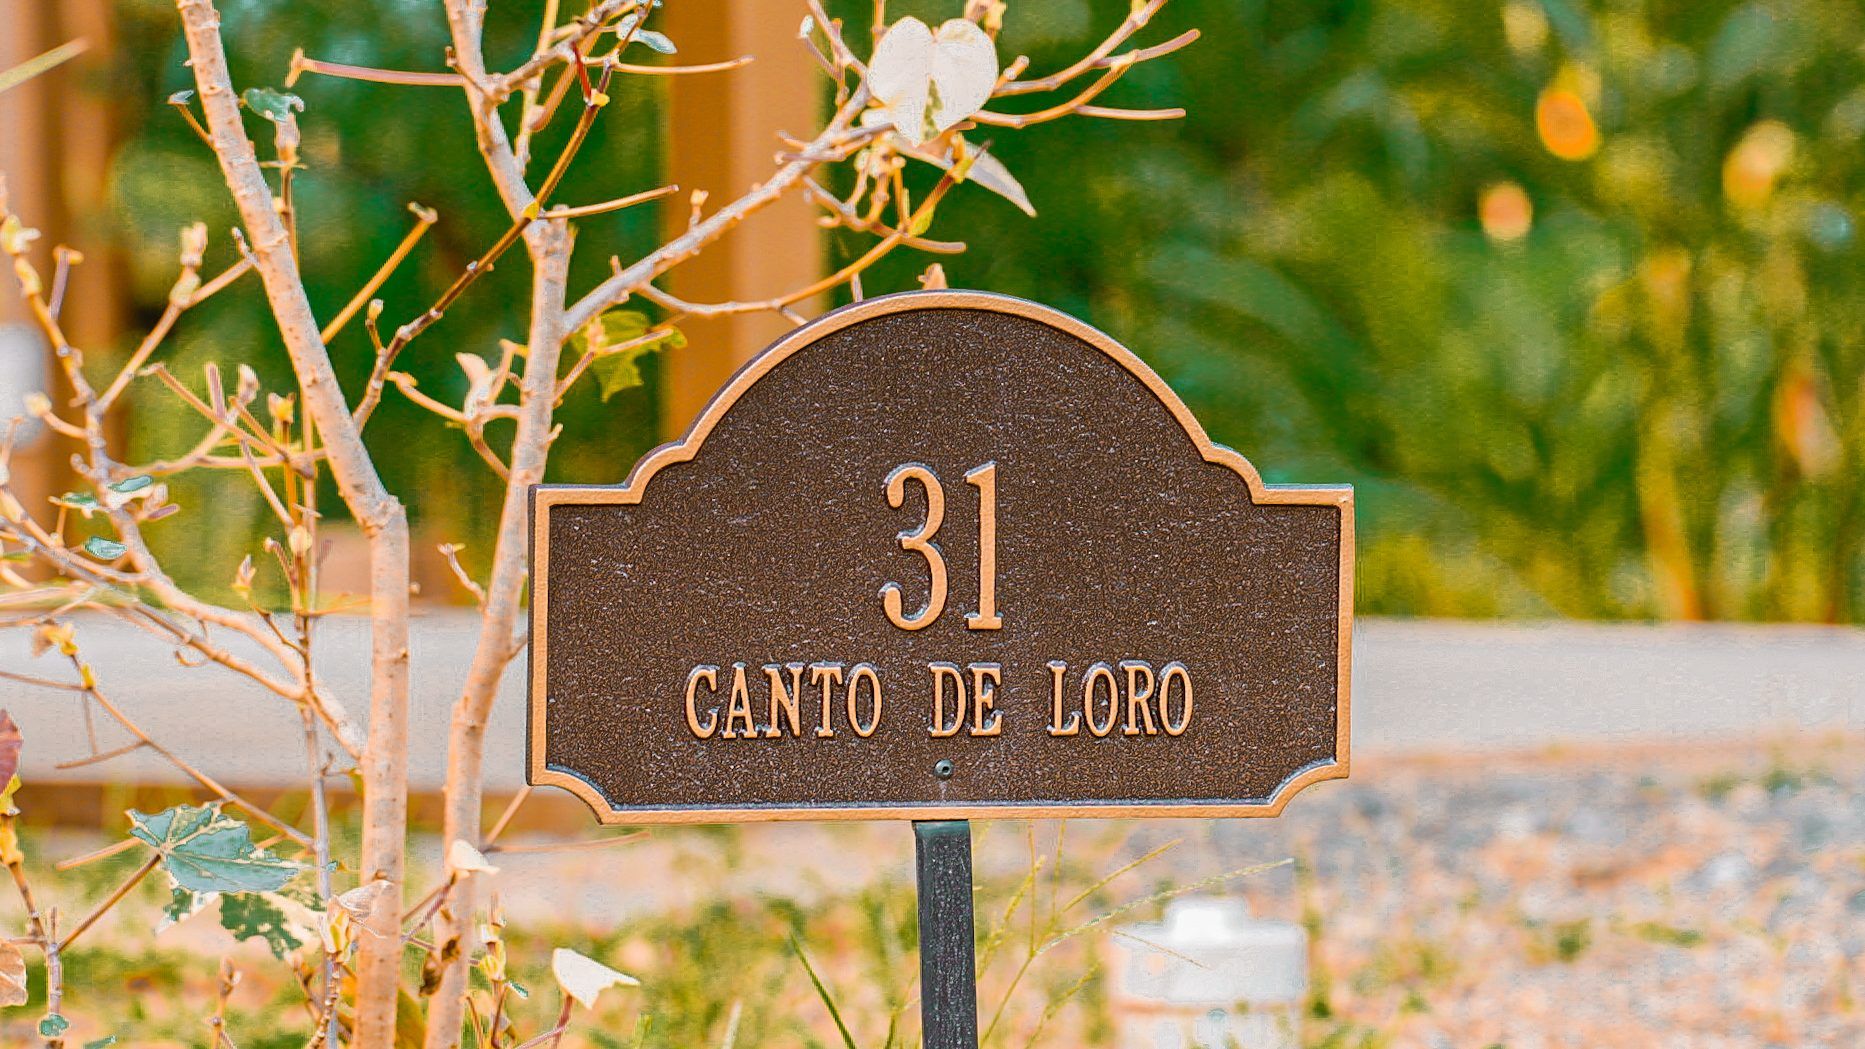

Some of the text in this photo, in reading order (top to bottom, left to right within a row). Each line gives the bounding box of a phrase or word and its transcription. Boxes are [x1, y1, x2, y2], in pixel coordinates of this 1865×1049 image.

[881, 461, 1003, 631] 31
[684, 661, 1194, 739] CANTO DE LORO
